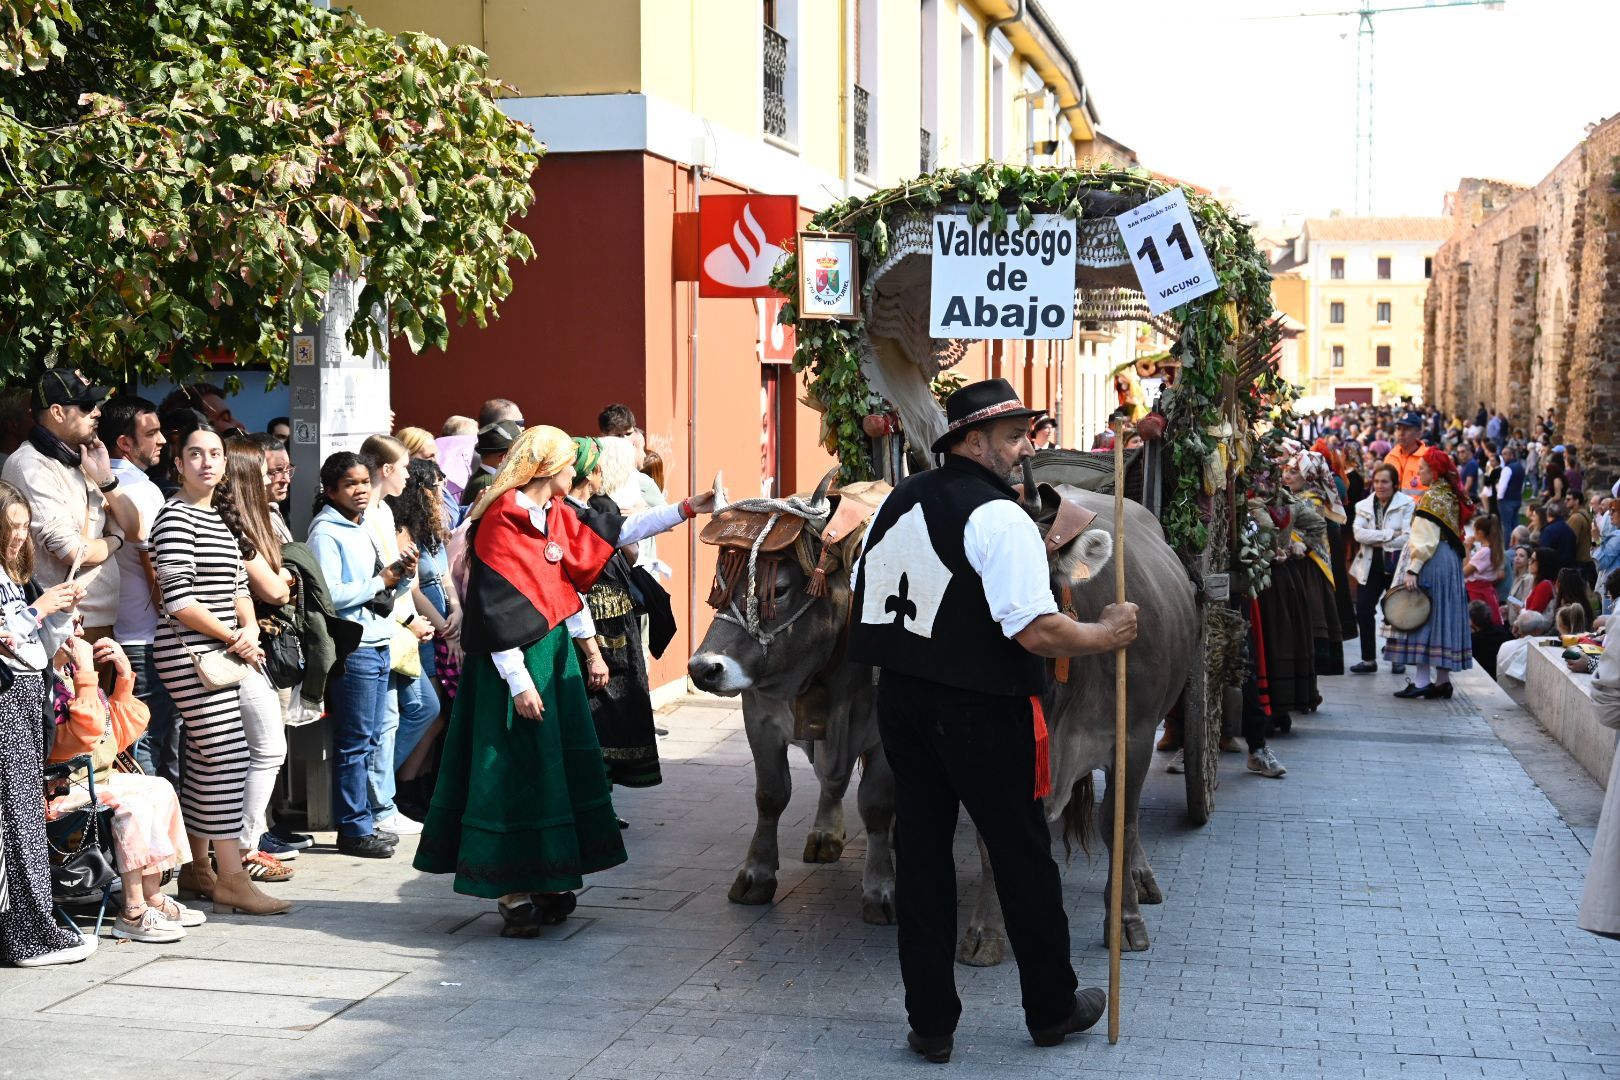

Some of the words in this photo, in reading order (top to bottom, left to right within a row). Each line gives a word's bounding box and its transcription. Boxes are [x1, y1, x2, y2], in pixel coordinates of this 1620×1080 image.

[1127, 220, 1140, 229] SAN
[1164, 202, 1178, 212] 2025
[936, 220, 1072, 266] Valdesogo
[1136, 222, 1195, 274] 11
[986, 261, 1028, 292] de
[1159, 275, 1201, 299] VACUNO
[814, 294, 823, 303] DE
[940, 295, 1066, 336] Abajo
